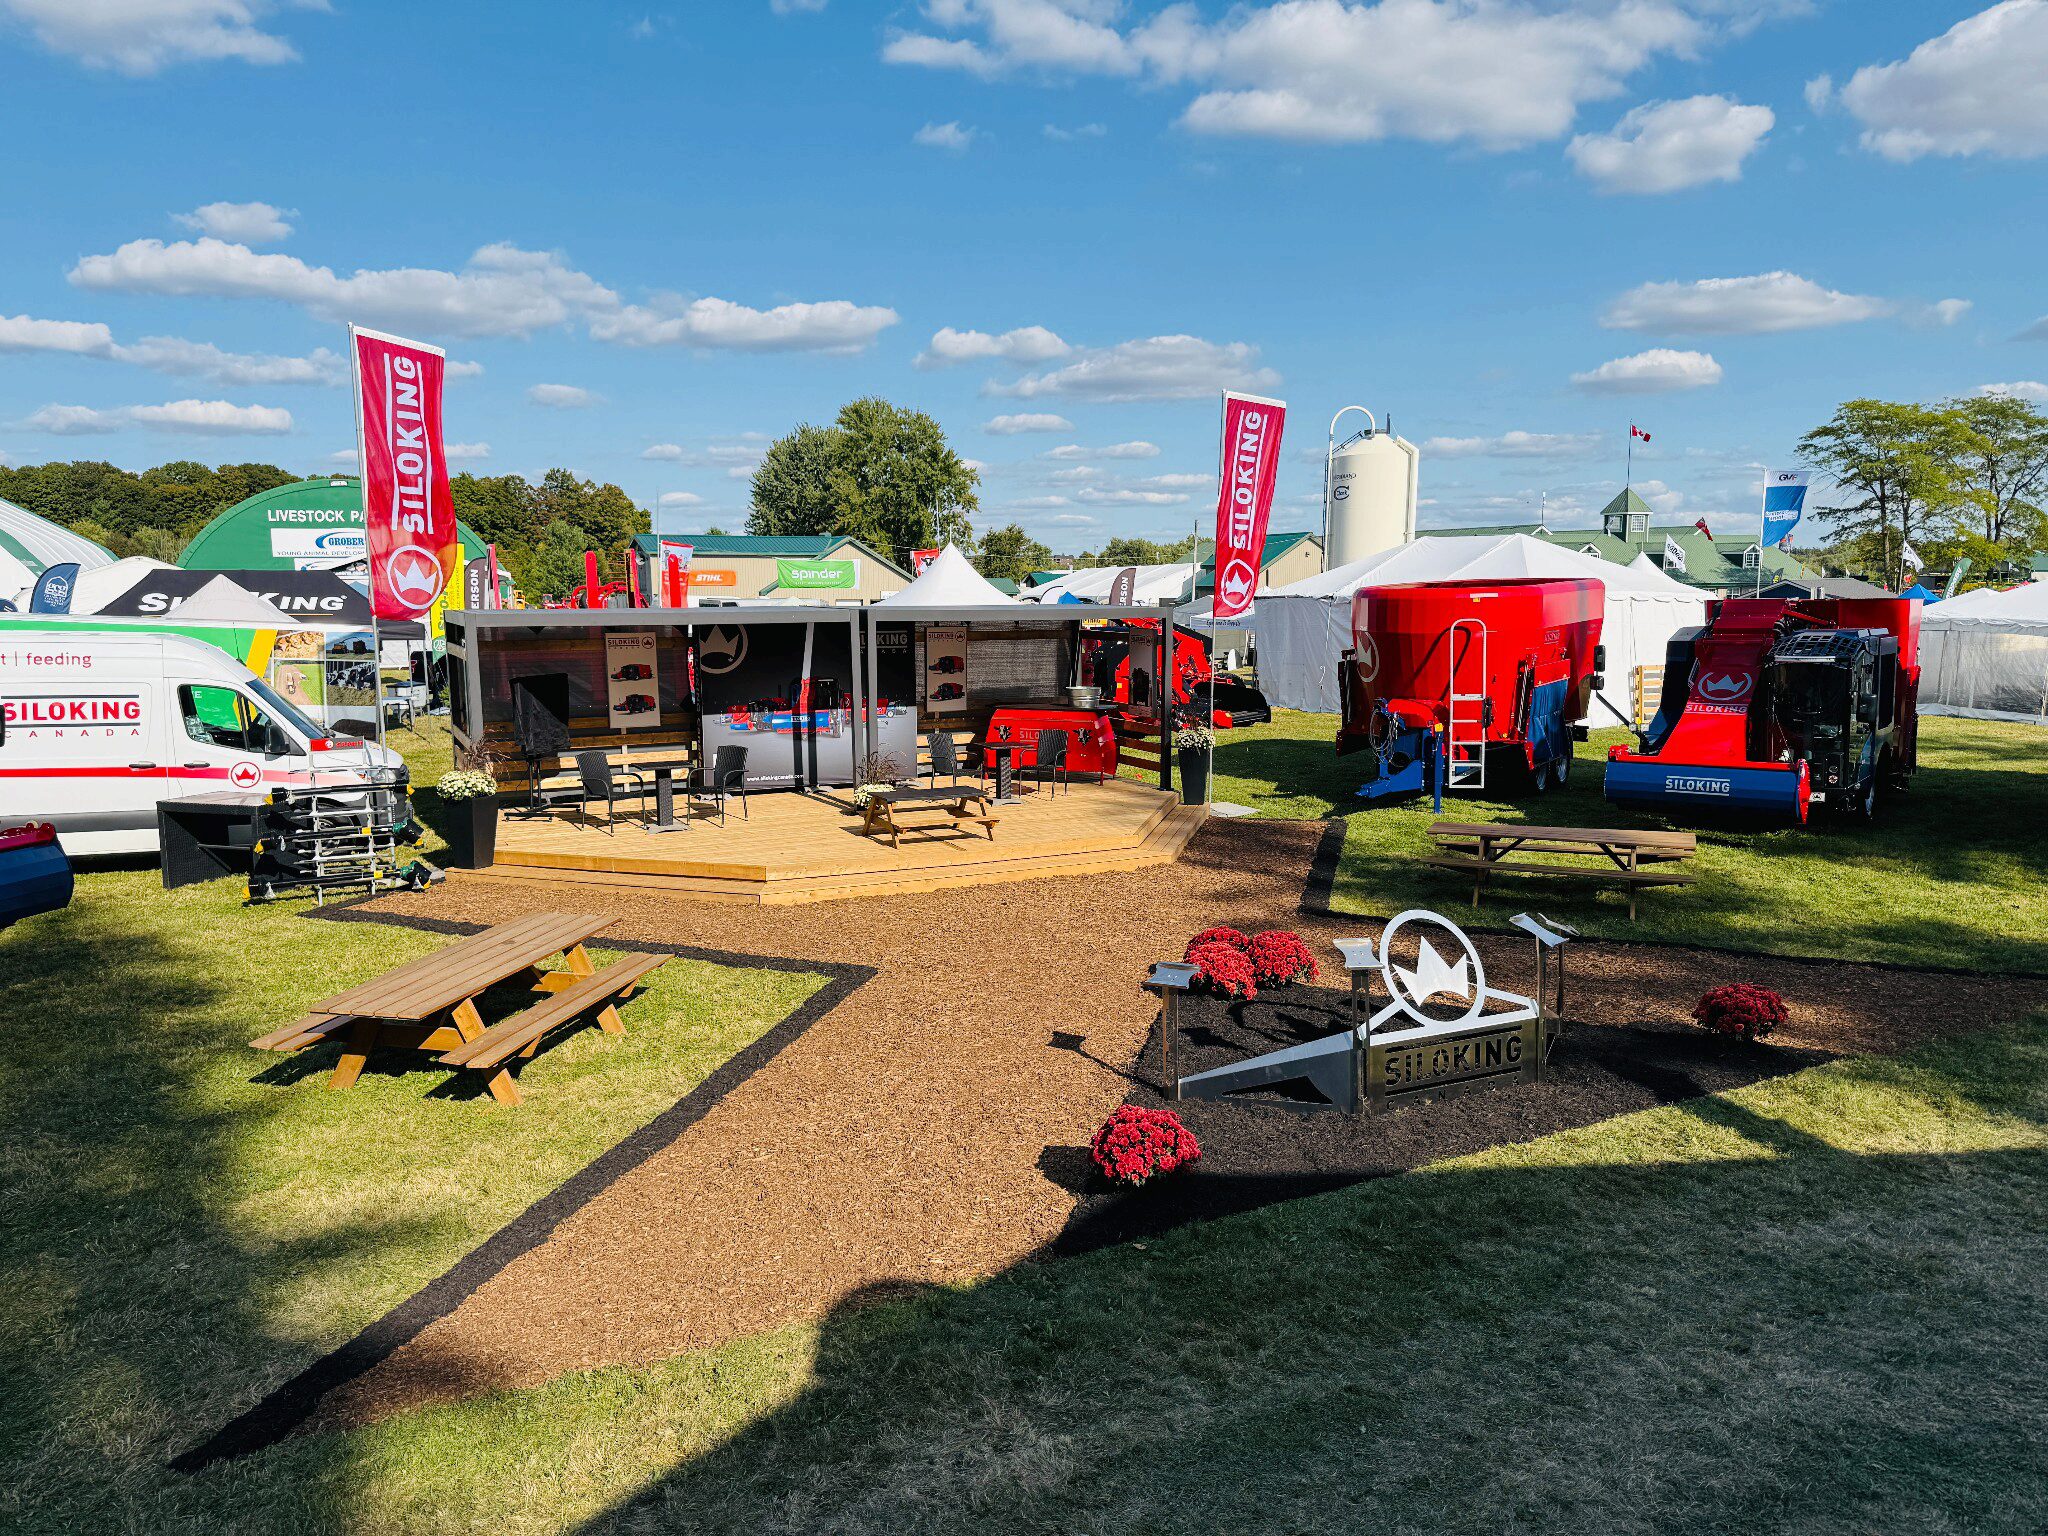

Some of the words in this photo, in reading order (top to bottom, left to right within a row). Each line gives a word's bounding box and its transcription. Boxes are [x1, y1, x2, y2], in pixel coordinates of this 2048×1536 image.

[393, 355, 424, 535] SILOKING
[1233, 410, 1262, 551] SILOKING
[267, 509, 345, 522] LIVESTOCK
[328, 537, 365, 546] GROBER
[695, 574, 722, 582] STIHL
[791, 569, 843, 580] spinder
[26, 652, 92, 669] feeding
[3, 701, 141, 722] SILOKING
[1685, 703, 1748, 714] SILOKING
[5, 729, 140, 739] CANADA
[1665, 778, 1730, 792] SILOKING
[1384, 1035, 1523, 1087] SILOKING
[1386, 1075, 1521, 1111] CANADA
